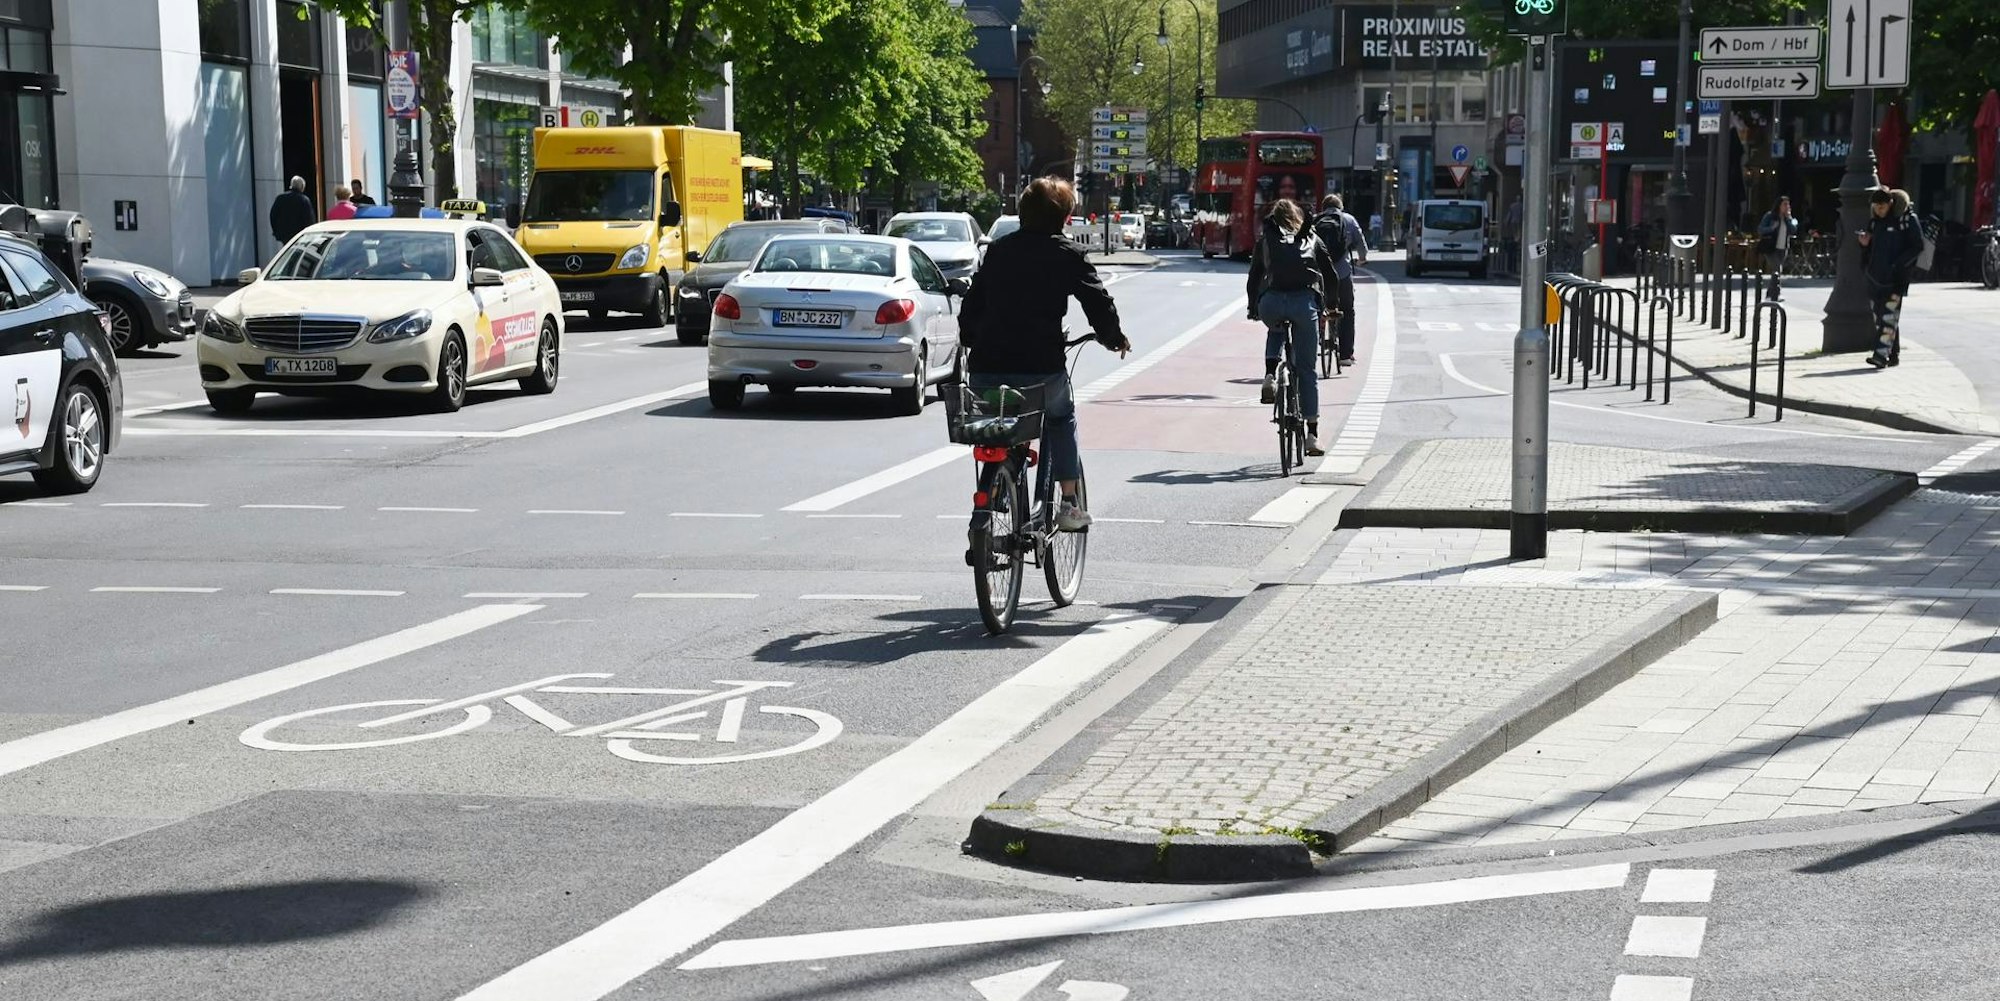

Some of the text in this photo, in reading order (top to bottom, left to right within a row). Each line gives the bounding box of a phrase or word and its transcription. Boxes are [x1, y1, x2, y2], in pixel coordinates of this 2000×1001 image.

[1363, 18, 1466, 36] PROXIMUS
[1362, 39, 1414, 57] REAL
[1732, 38, 1765, 52] Dom
[1784, 37, 1809, 51] Hbf
[389, 55, 408, 69] Volt
[1705, 76, 1786, 93] Rudolfplatz
[1702, 100, 1720, 111] TAXI
[545, 114, 556, 128] B
[1612, 129, 1622, 140] A
[575, 146, 618, 155] DHL
[447, 201, 476, 210] TAXI
[780, 310, 840, 325] BN JC 237
[273, 360, 334, 372] K TX 1208
